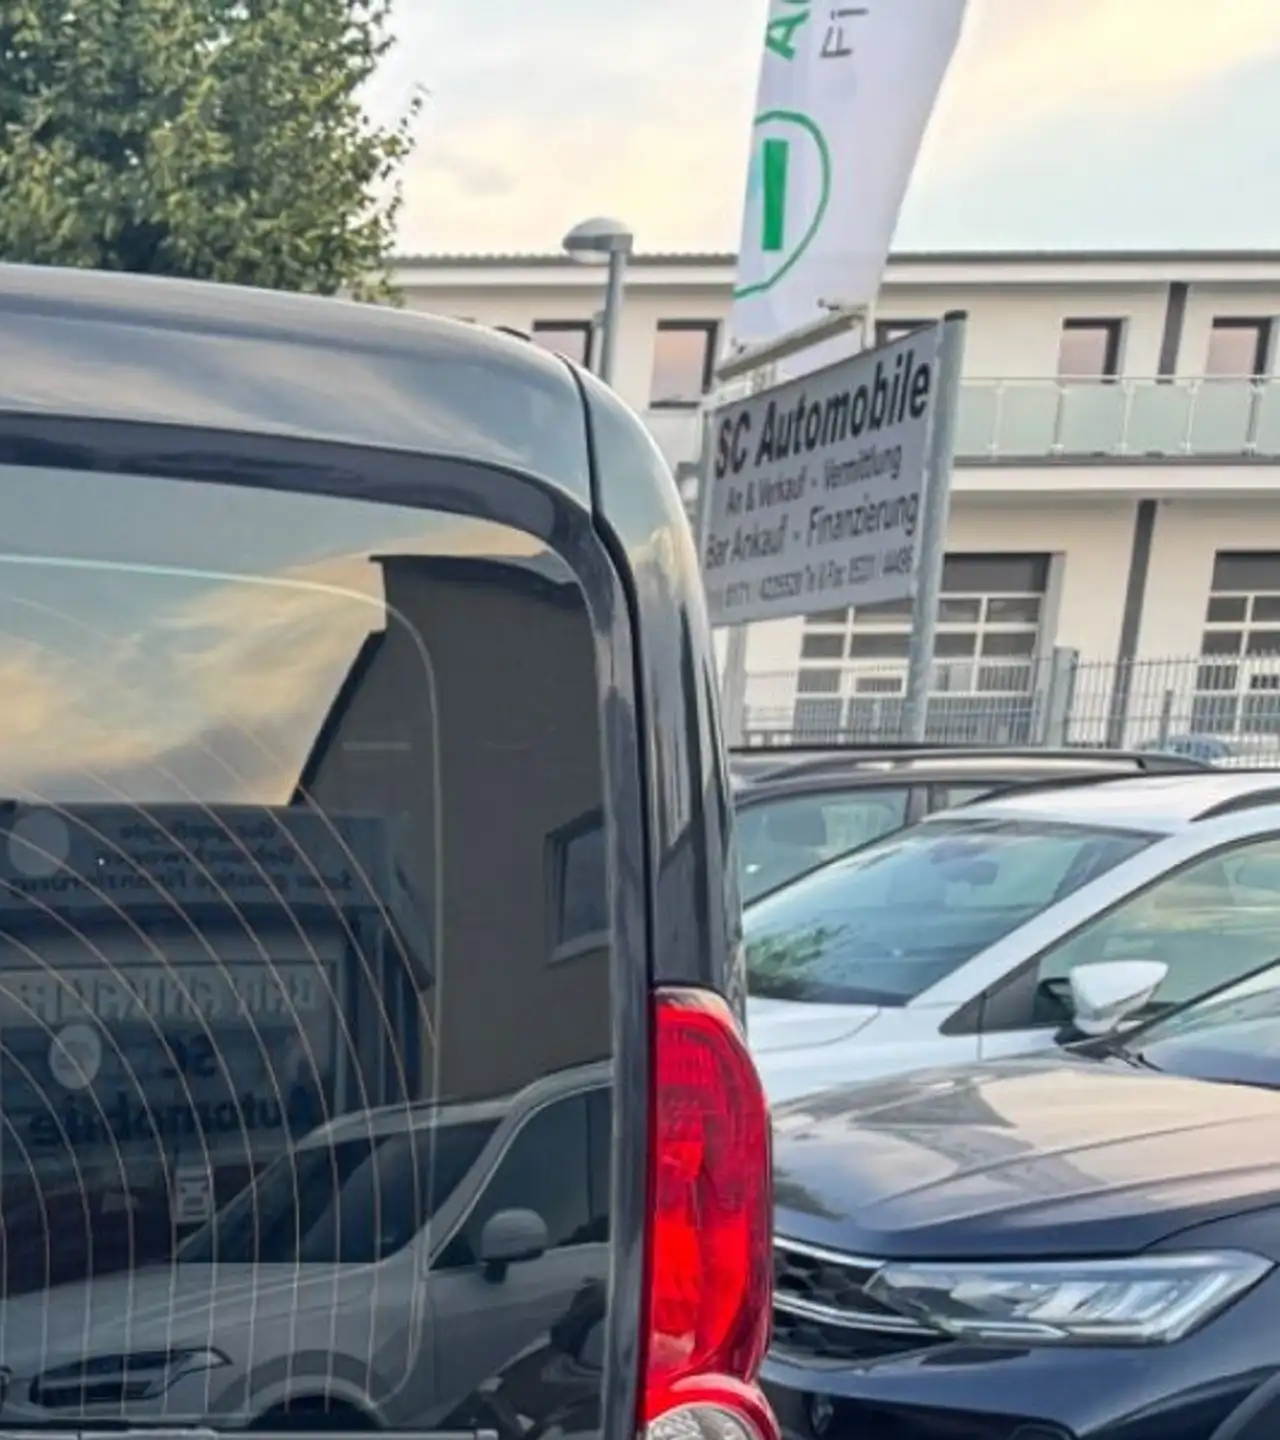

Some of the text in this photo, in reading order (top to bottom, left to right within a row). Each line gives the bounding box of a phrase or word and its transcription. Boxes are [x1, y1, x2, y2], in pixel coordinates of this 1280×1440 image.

[715, 349, 931, 480] SC Automobile
[730, 512, 790, 564] Ankauf
[806, 491, 920, 549] Finanzierung
